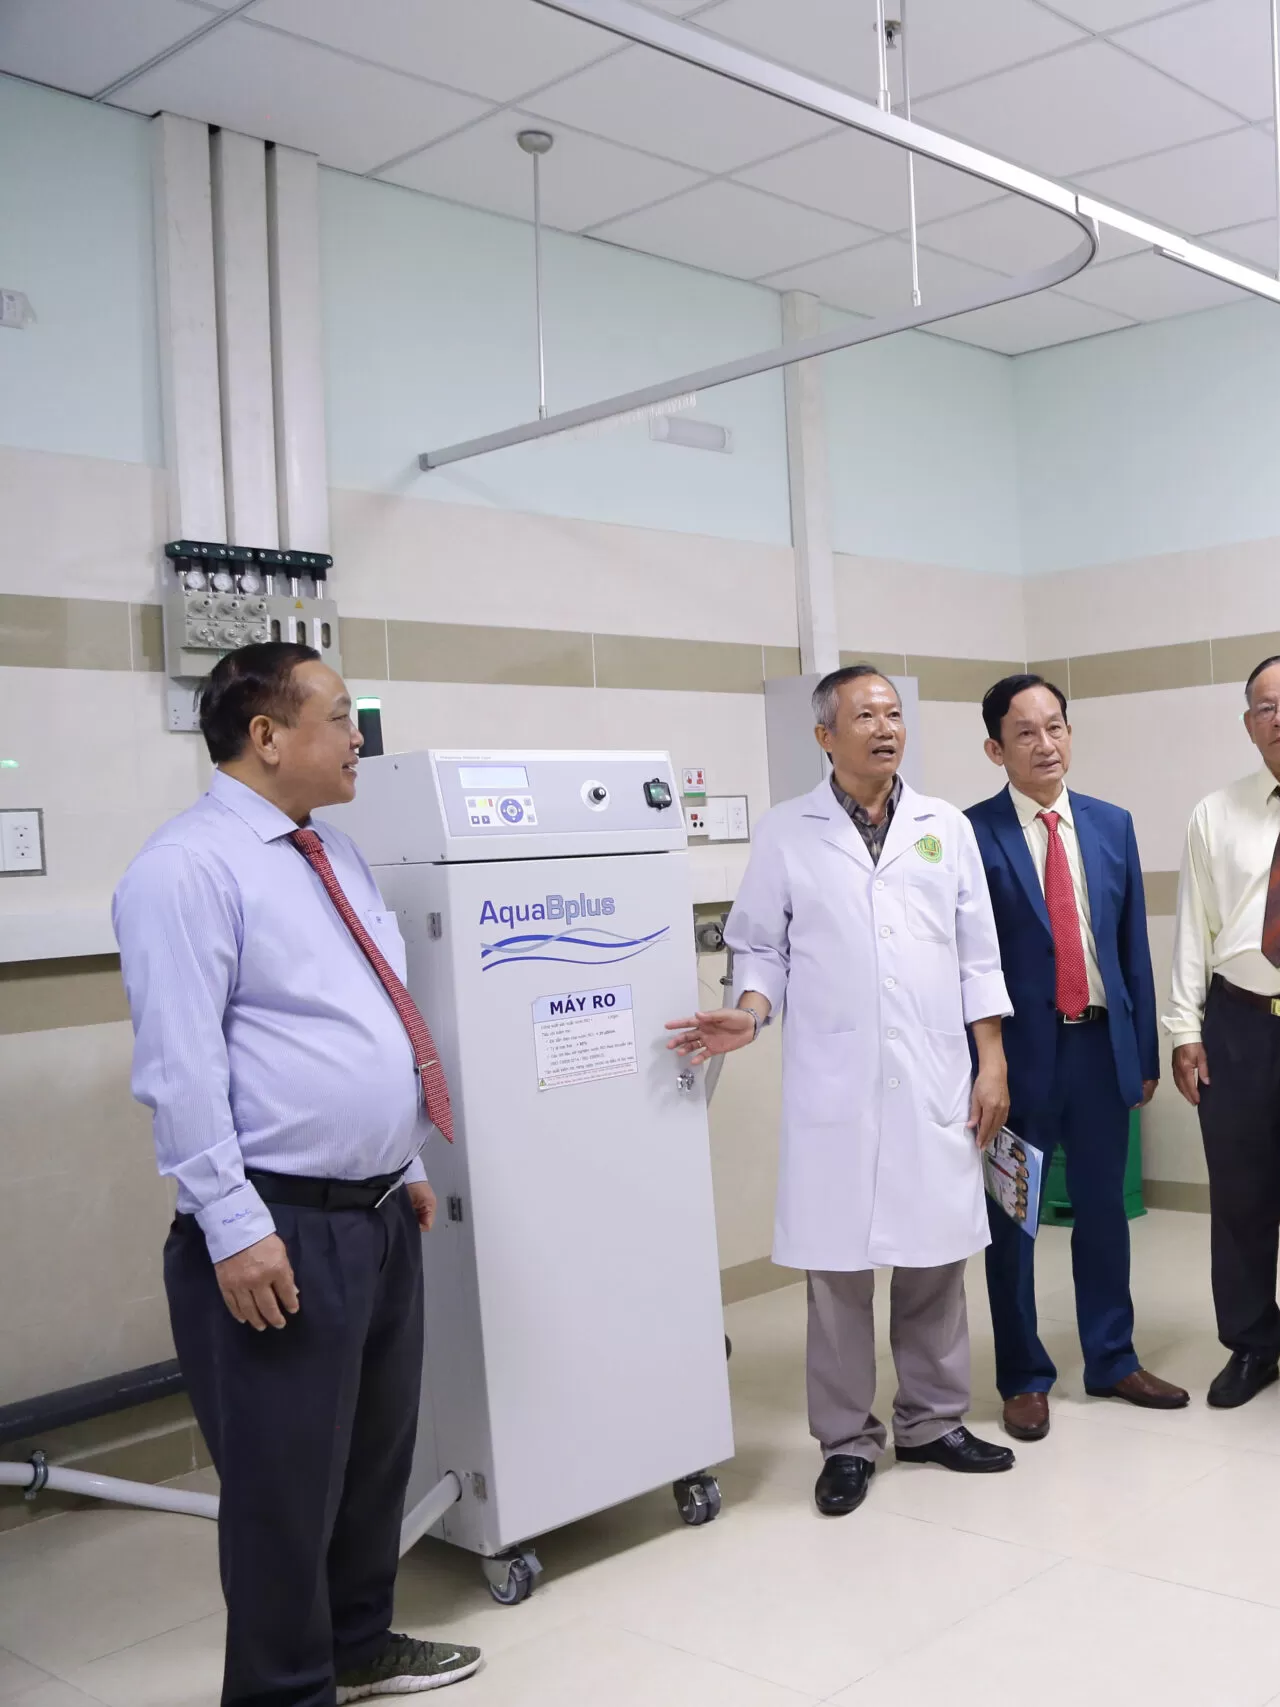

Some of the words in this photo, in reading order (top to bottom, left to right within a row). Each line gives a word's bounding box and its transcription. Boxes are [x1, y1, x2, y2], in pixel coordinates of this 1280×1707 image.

[480, 893, 616, 930] AquaBplus
[549, 994, 586, 1015] MÁY
[592, 993, 616, 1009] RO
